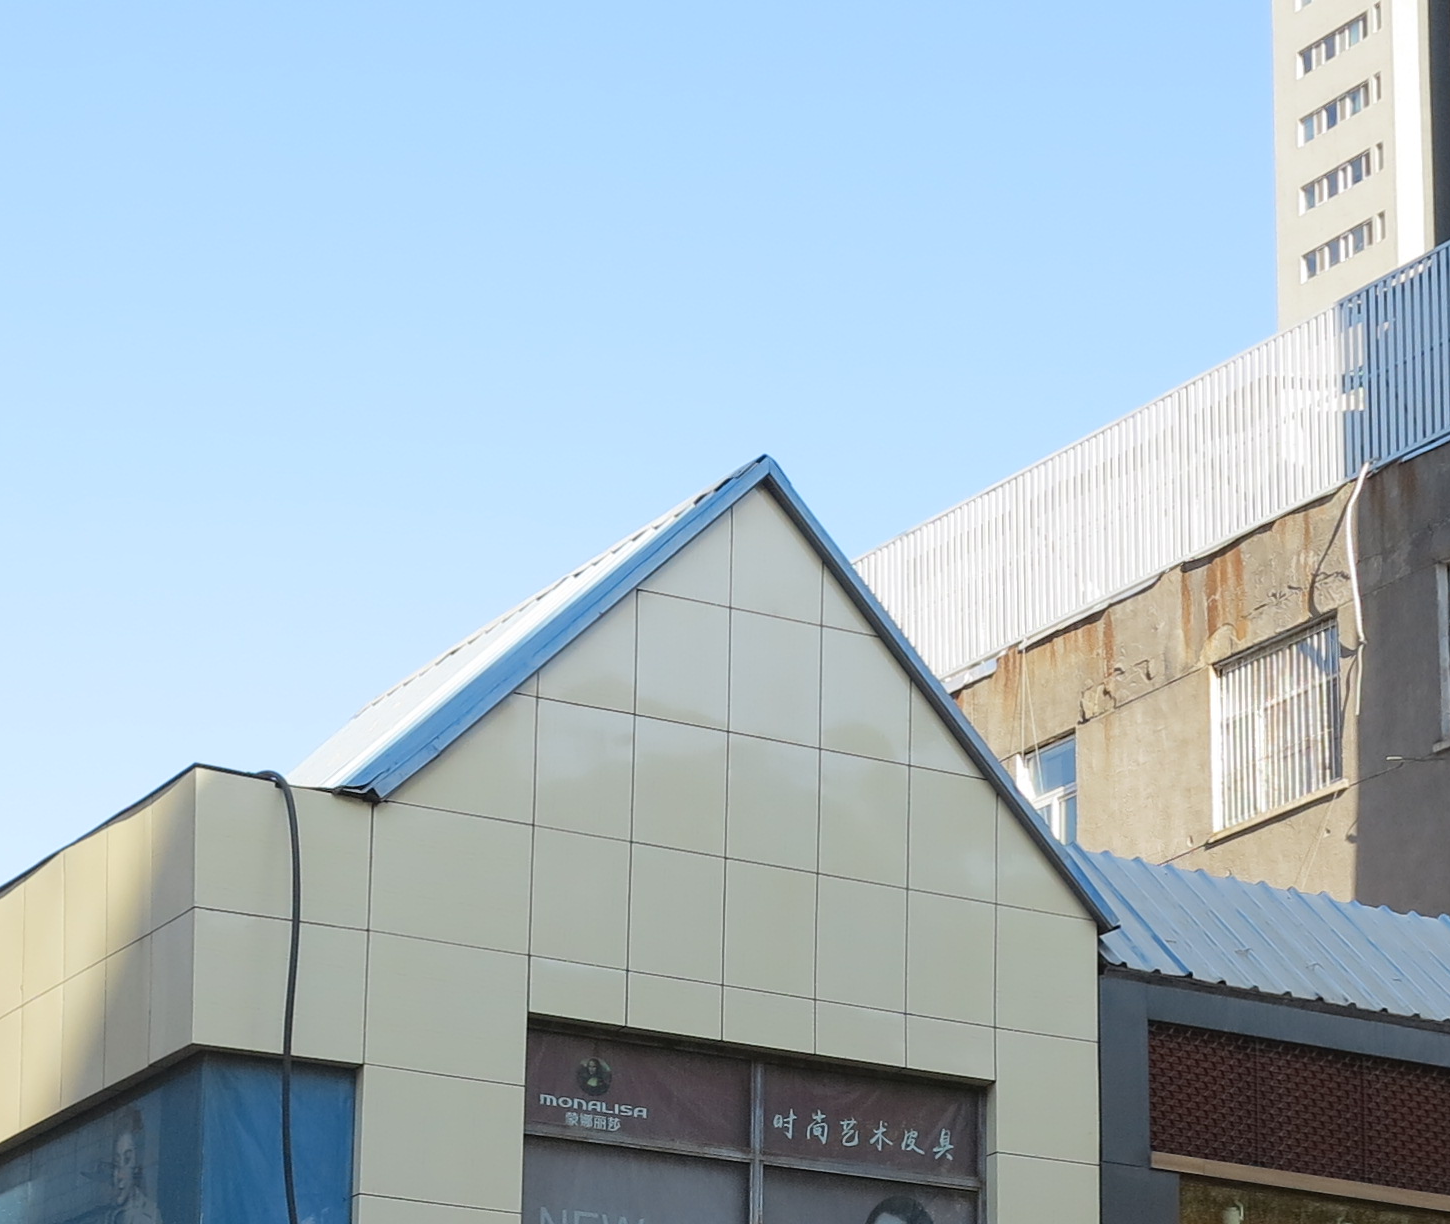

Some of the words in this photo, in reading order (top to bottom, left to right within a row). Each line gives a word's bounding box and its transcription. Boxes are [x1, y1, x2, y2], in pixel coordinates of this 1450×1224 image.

[539, 1094, 648, 1119] MONALISA
[772, 1109, 955, 1161] 时尚艺术皮具
